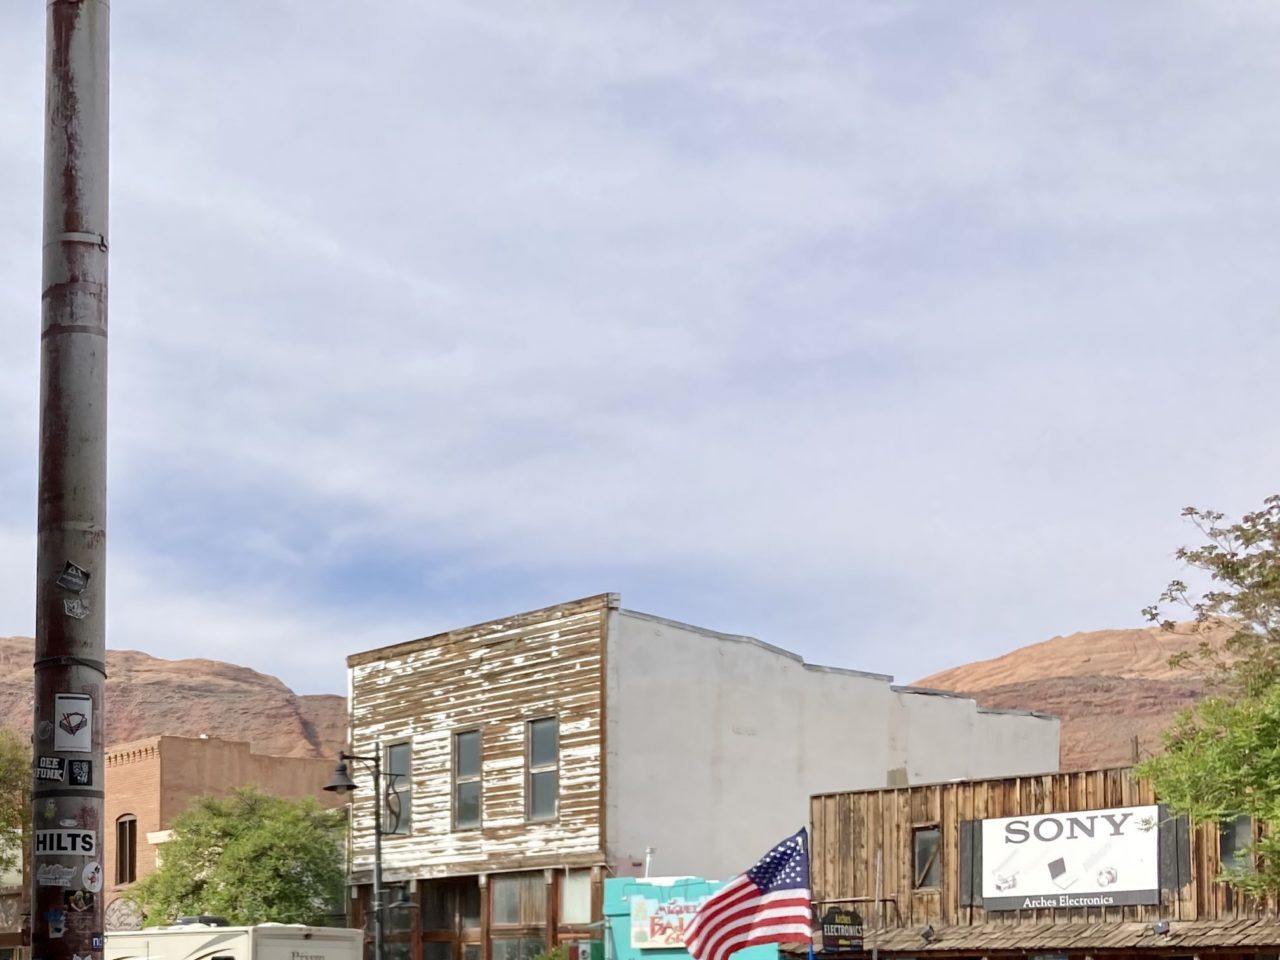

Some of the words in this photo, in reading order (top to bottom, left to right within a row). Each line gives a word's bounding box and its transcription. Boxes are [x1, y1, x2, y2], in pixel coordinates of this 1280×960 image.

[1005, 813, 1133, 844] SONY
[36, 833, 93, 852] HILTS
[1023, 896, 1057, 908] Arches
[1059, 895, 1114, 907] Electronics
[650, 916, 686, 938] BAJ
